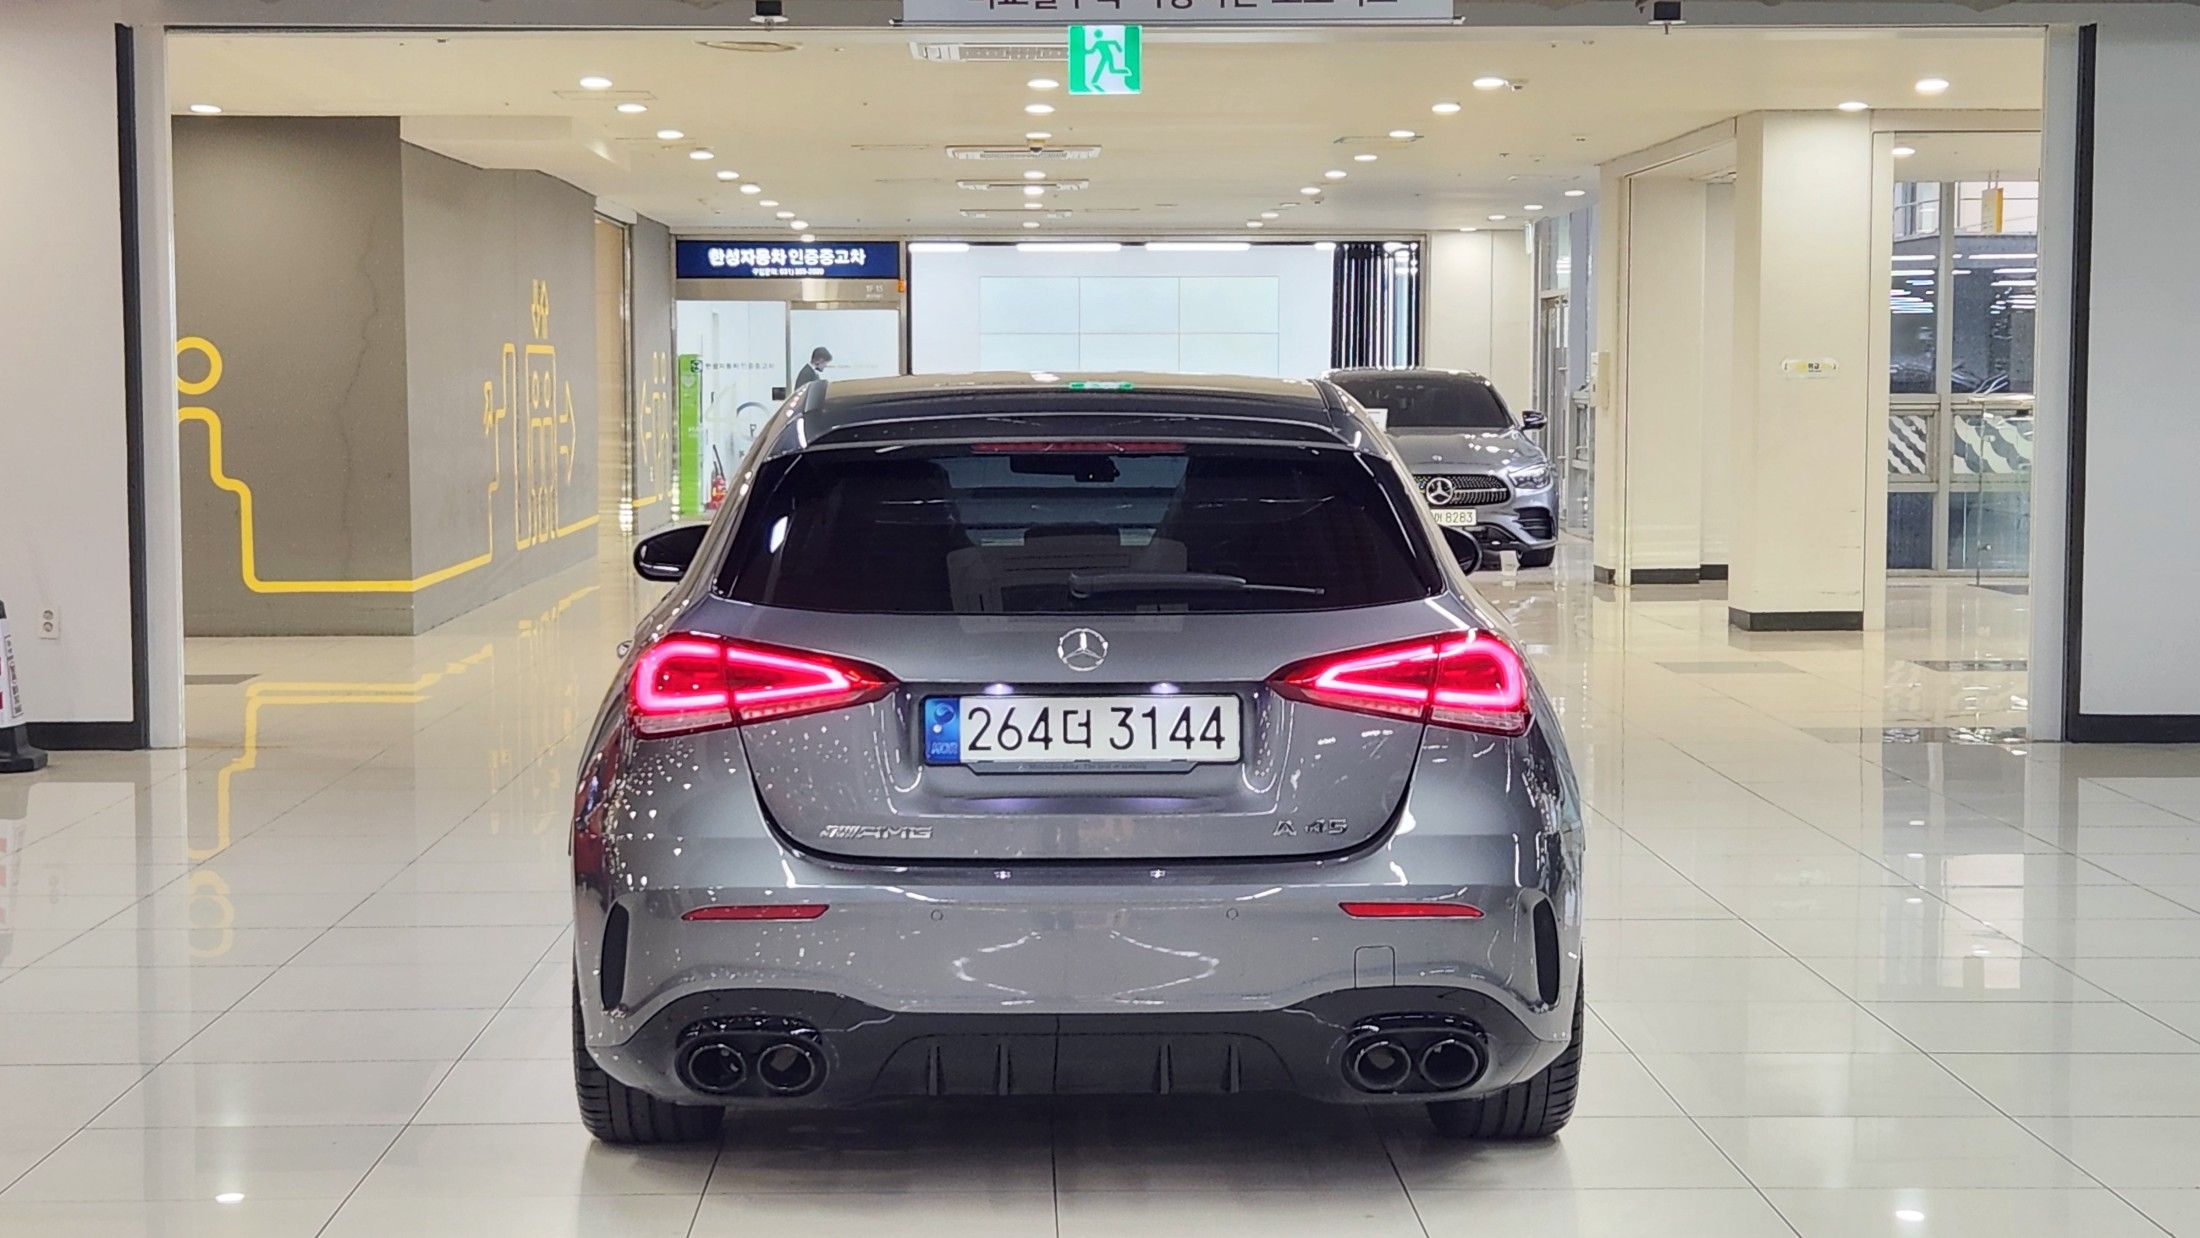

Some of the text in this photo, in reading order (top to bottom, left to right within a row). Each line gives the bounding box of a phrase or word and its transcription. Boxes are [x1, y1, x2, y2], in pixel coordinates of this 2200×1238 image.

[708, 247, 866, 267] 한성자동차 인증중고차
[968, 705, 1226, 751] 264더 3144
[852, 825, 933, 839] AMG
[1273, 819, 1348, 836] A 45
